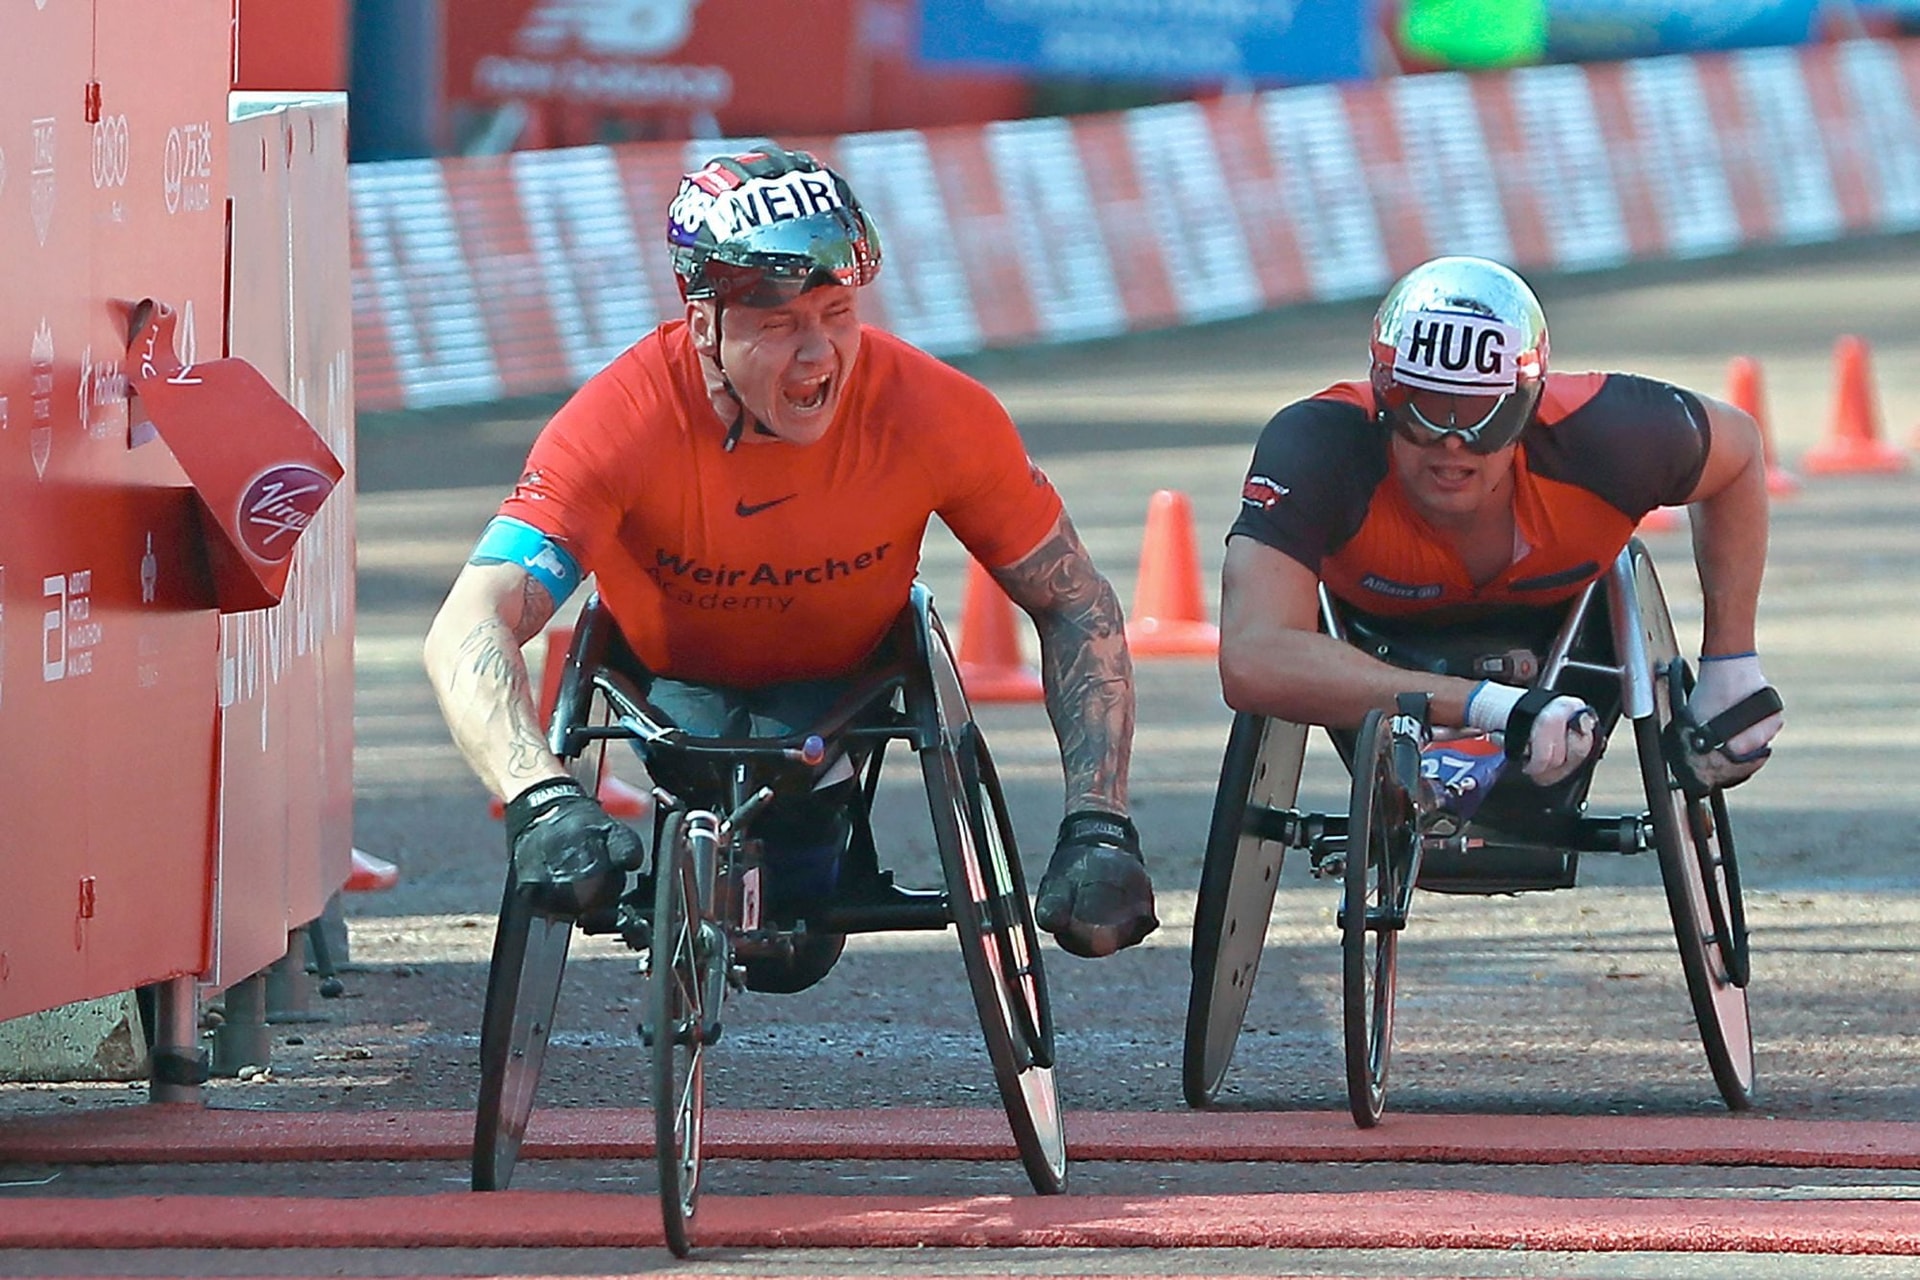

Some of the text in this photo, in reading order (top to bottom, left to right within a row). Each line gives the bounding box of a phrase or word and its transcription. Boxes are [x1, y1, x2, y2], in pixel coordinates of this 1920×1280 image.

[717, 178, 843, 233] WEIR
[1408, 320, 1505, 374] HUG
[656, 542, 892, 586] WeirArcher
[1363, 577, 1415, 597] Allianz
